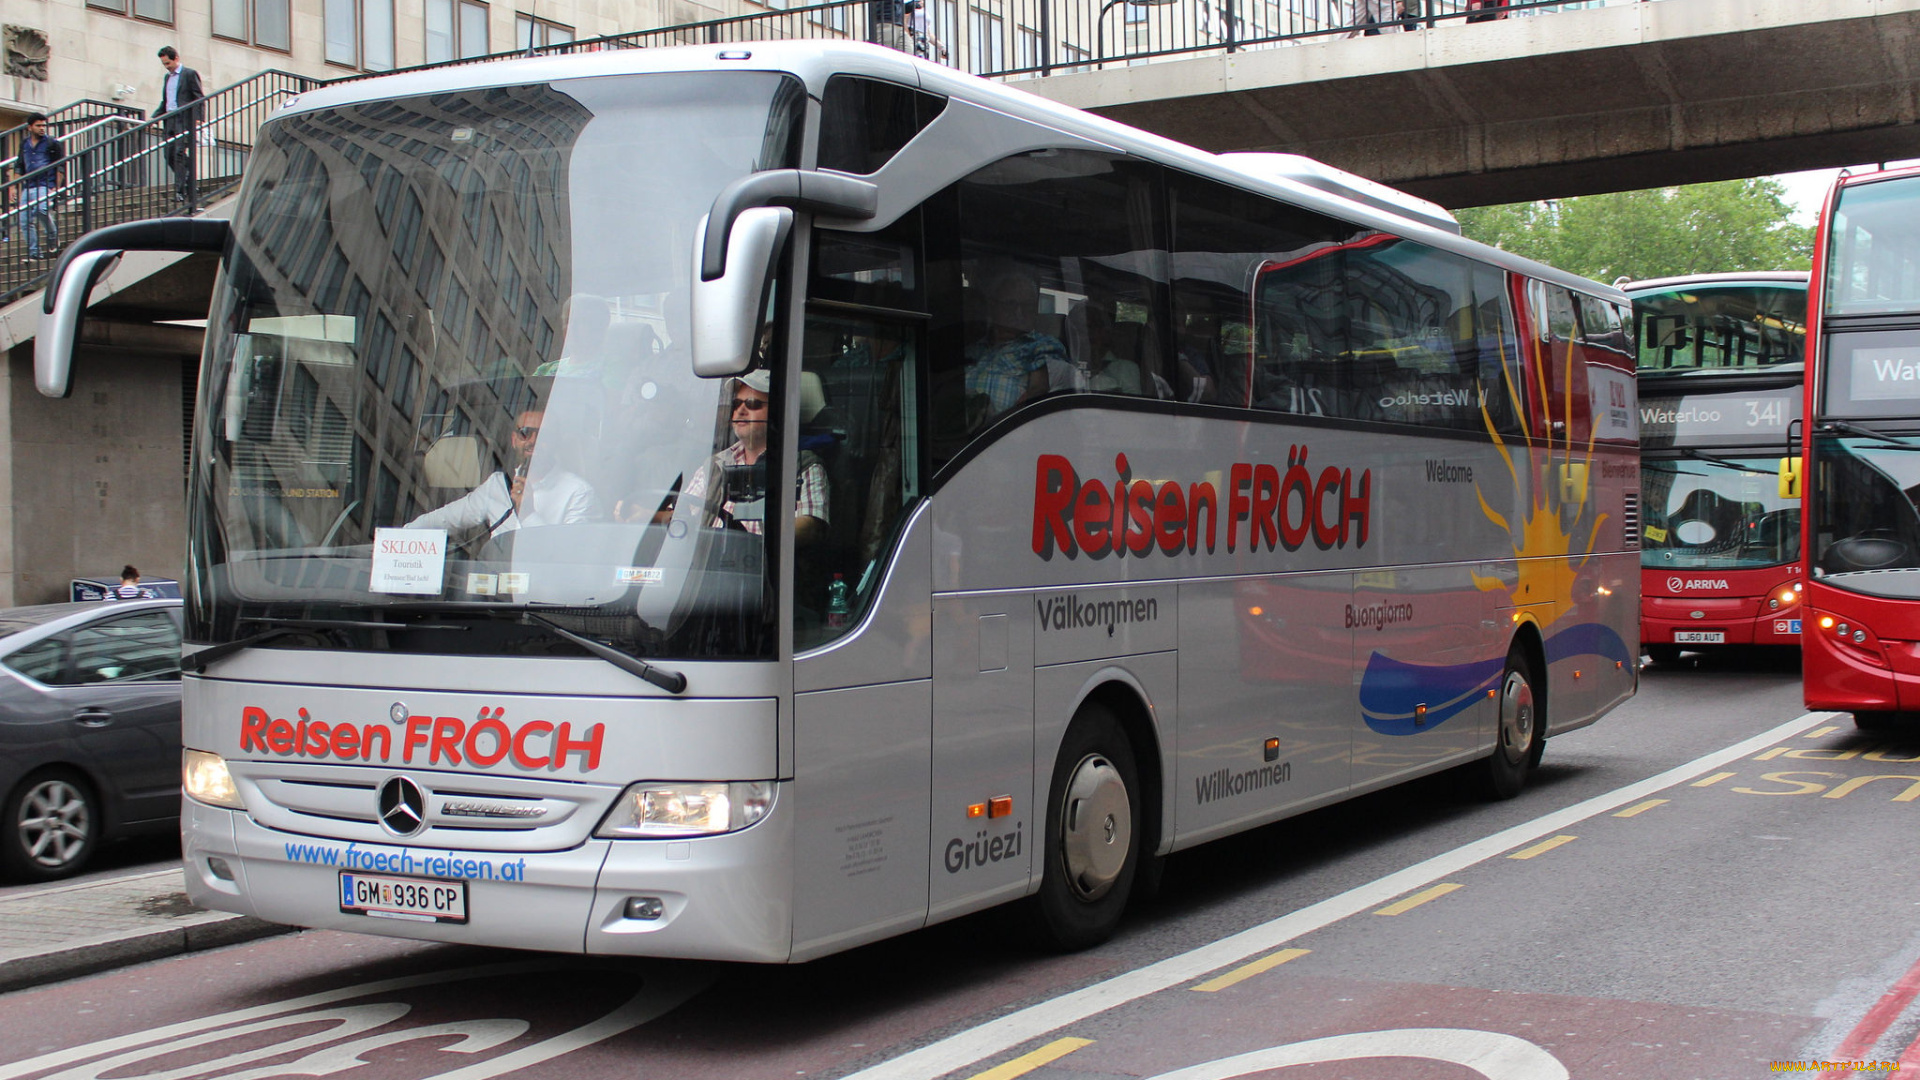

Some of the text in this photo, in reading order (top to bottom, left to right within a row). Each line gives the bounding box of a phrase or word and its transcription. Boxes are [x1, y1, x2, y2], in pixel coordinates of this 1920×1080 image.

[1874, 359, 1920, 381] Wat
[1640, 407, 1721, 424] Waterloo
[1745, 401, 1781, 427] 341
[1426, 459, 1473, 483] Welcome
[1032, 444, 1372, 561] Reisen FRÖCH
[381, 540, 438, 555] SKLONA
[393, 560, 423, 569] Touristik
[1684, 579, 1730, 590] ARRIVA
[1038, 596, 1159, 632] Välkommen
[1344, 600, 1413, 631] Buongiorno
[1678, 632, 1722, 642] LJ60 AUT
[240, 706, 605, 772] Reisen FRÖCH
[1195, 761, 1291, 805] Willkommen
[944, 821, 1022, 874] Grüezi
[285, 842, 527, 882] www.froech-reisen.at
[346, 893, 352, 901] A
[356, 880, 457, 911] GM 936 CP
